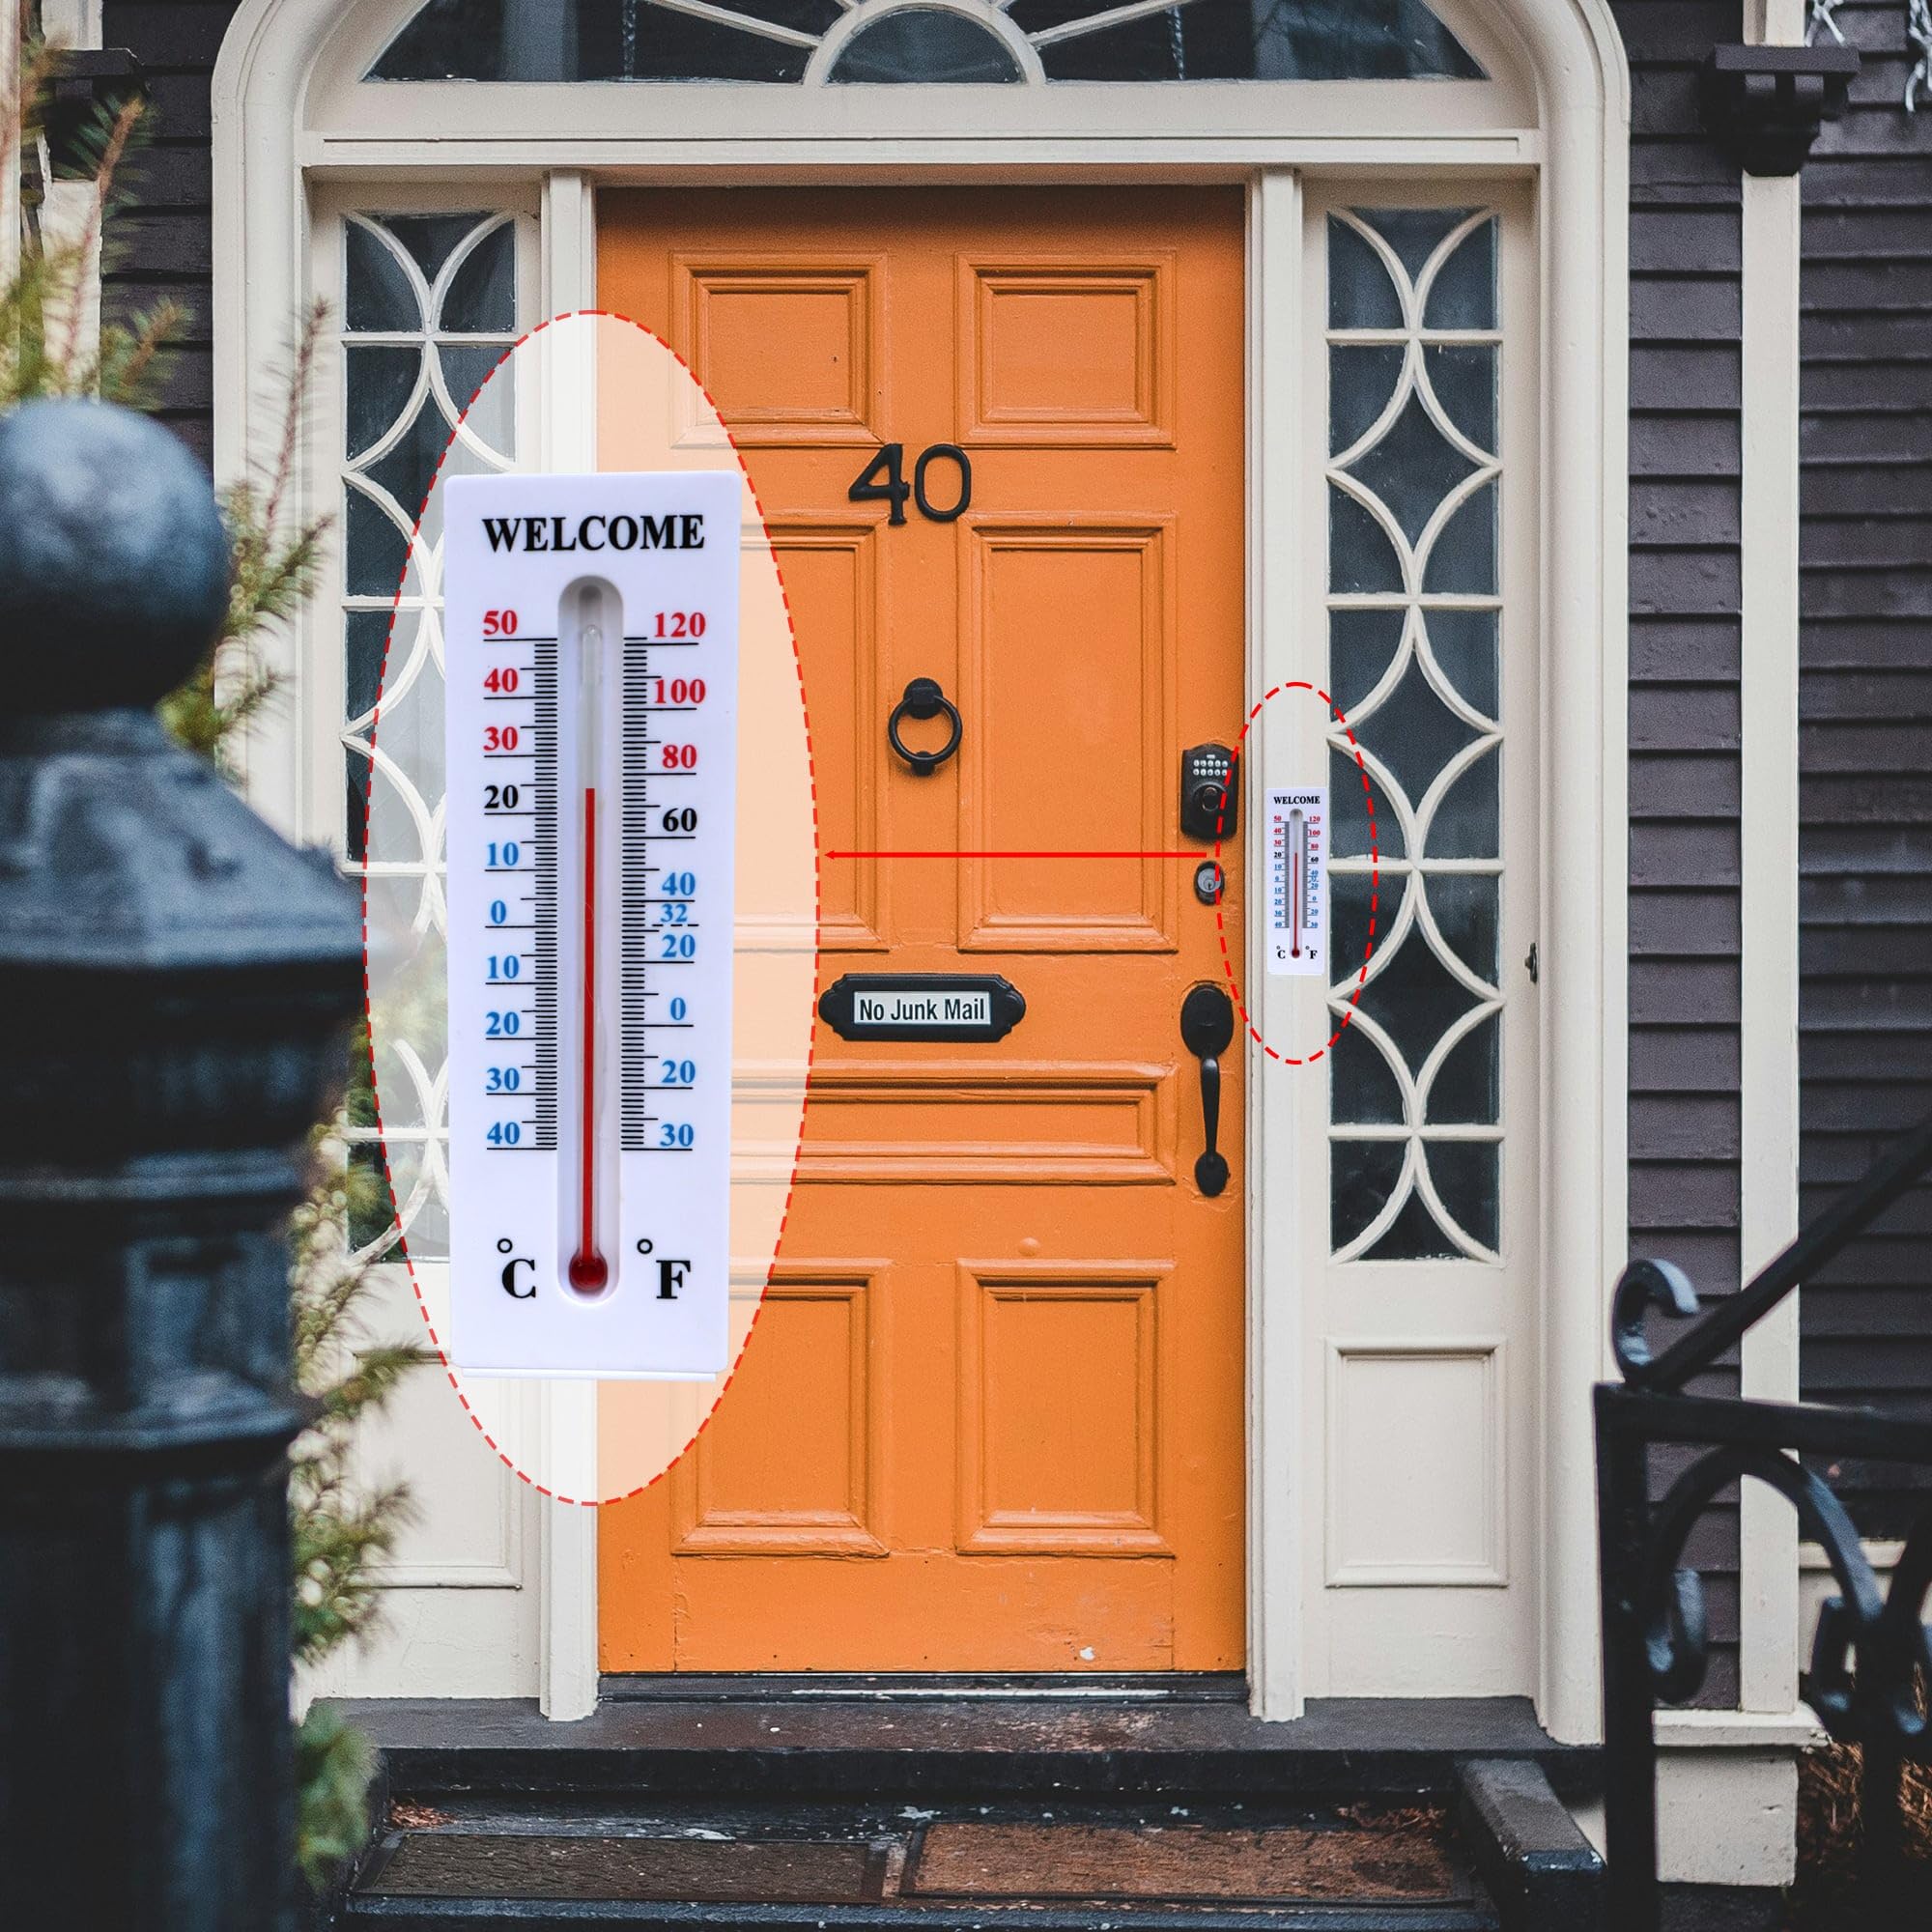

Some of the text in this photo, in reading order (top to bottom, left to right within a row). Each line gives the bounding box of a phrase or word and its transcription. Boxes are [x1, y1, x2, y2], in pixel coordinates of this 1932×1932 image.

[847, 442, 974, 526] 40
[482, 514, 705, 553] WELCOME
[484, 611, 517, 635] 50
[656, 612, 705, 638] 120
[484, 668, 518, 693] 40
[657, 679, 705, 703] 100
[484, 726, 518, 751] 30
[663, 745, 696, 768] 80
[484, 784, 519, 808] 20
[663, 808, 697, 832] 60
[489, 842, 519, 866] 10
[662, 872, 696, 895] 40
[491, 900, 506, 924] 0
[661, 903, 687, 924] 32
[662, 934, 696, 957] 20
[489, 955, 519, 979] 10
[670, 998, 686, 1020] 0
[860, 998, 984, 1021] No Junk Mail
[486, 1011, 519, 1035] 20
[486, 1067, 520, 1091] 30
[662, 1061, 696, 1083] 20
[487, 1122, 520, 1145] 40
[660, 1123, 694, 1147] 30
